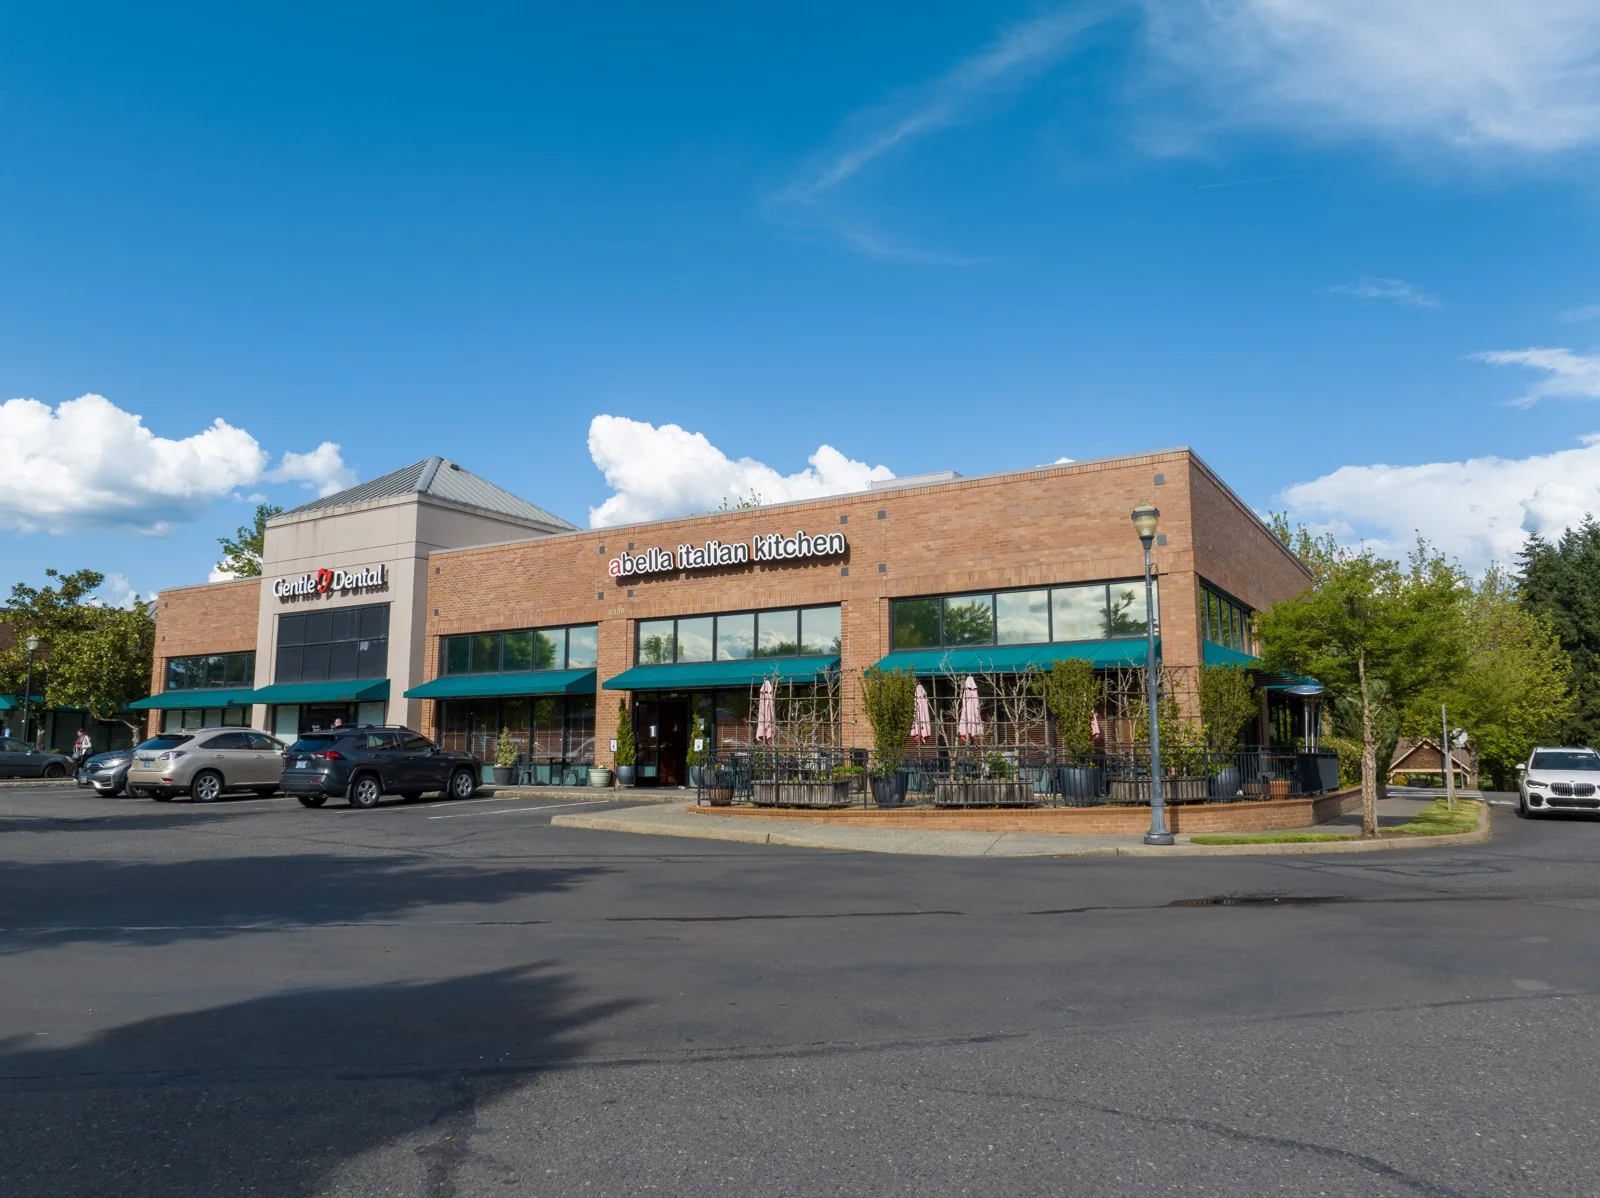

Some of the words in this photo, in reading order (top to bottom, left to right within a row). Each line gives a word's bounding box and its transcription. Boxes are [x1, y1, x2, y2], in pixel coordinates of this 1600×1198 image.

[609, 547, 674, 577] abella
[678, 540, 748, 570] italian
[753, 531, 846, 560] kitchen
[272, 574, 316, 597] Gentle
[333, 564, 384, 590] Dental
